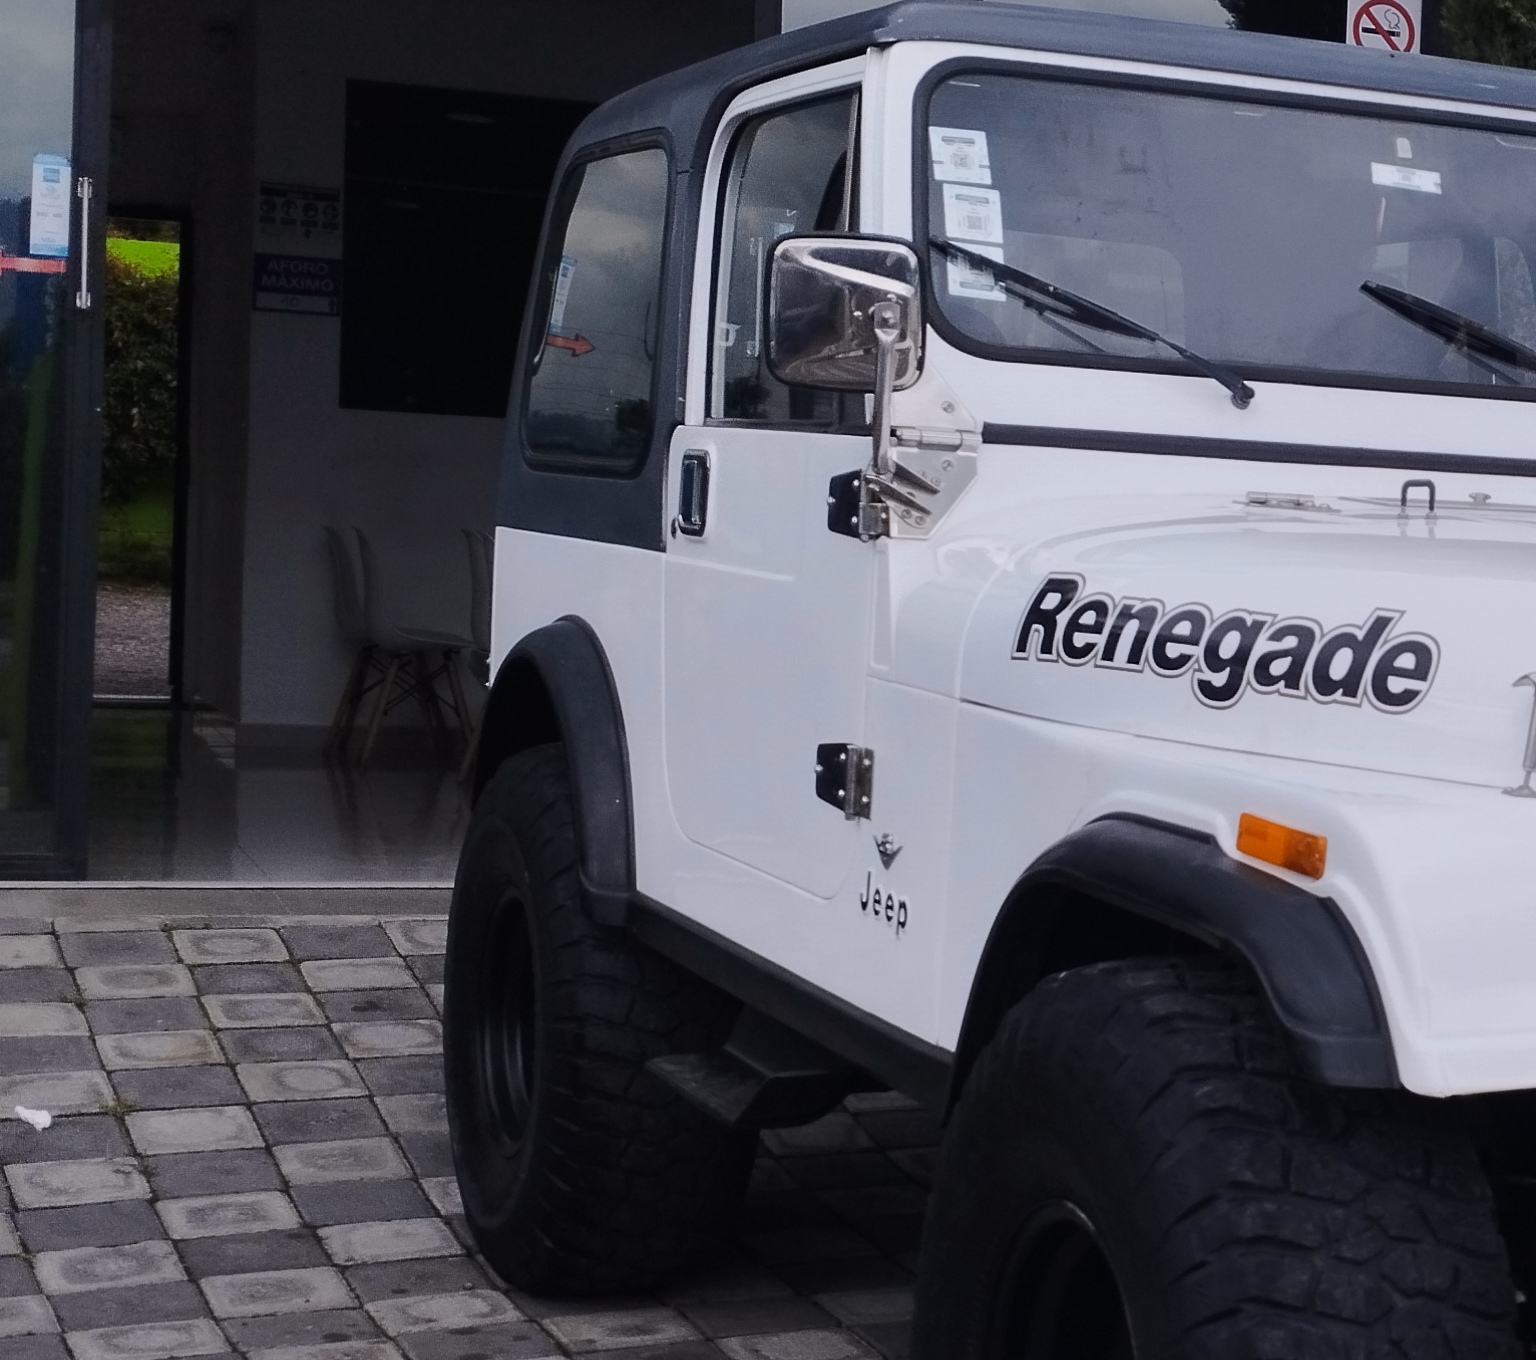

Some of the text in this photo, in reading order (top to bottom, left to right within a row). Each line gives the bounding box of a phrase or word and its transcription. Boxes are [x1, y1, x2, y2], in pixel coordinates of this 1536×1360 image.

[261, 273, 334, 291] MÁXIMO
[268, 260, 328, 275] AFORO
[1012, 571, 1441, 714] Renegade
[860, 871, 908, 937] Jeep
